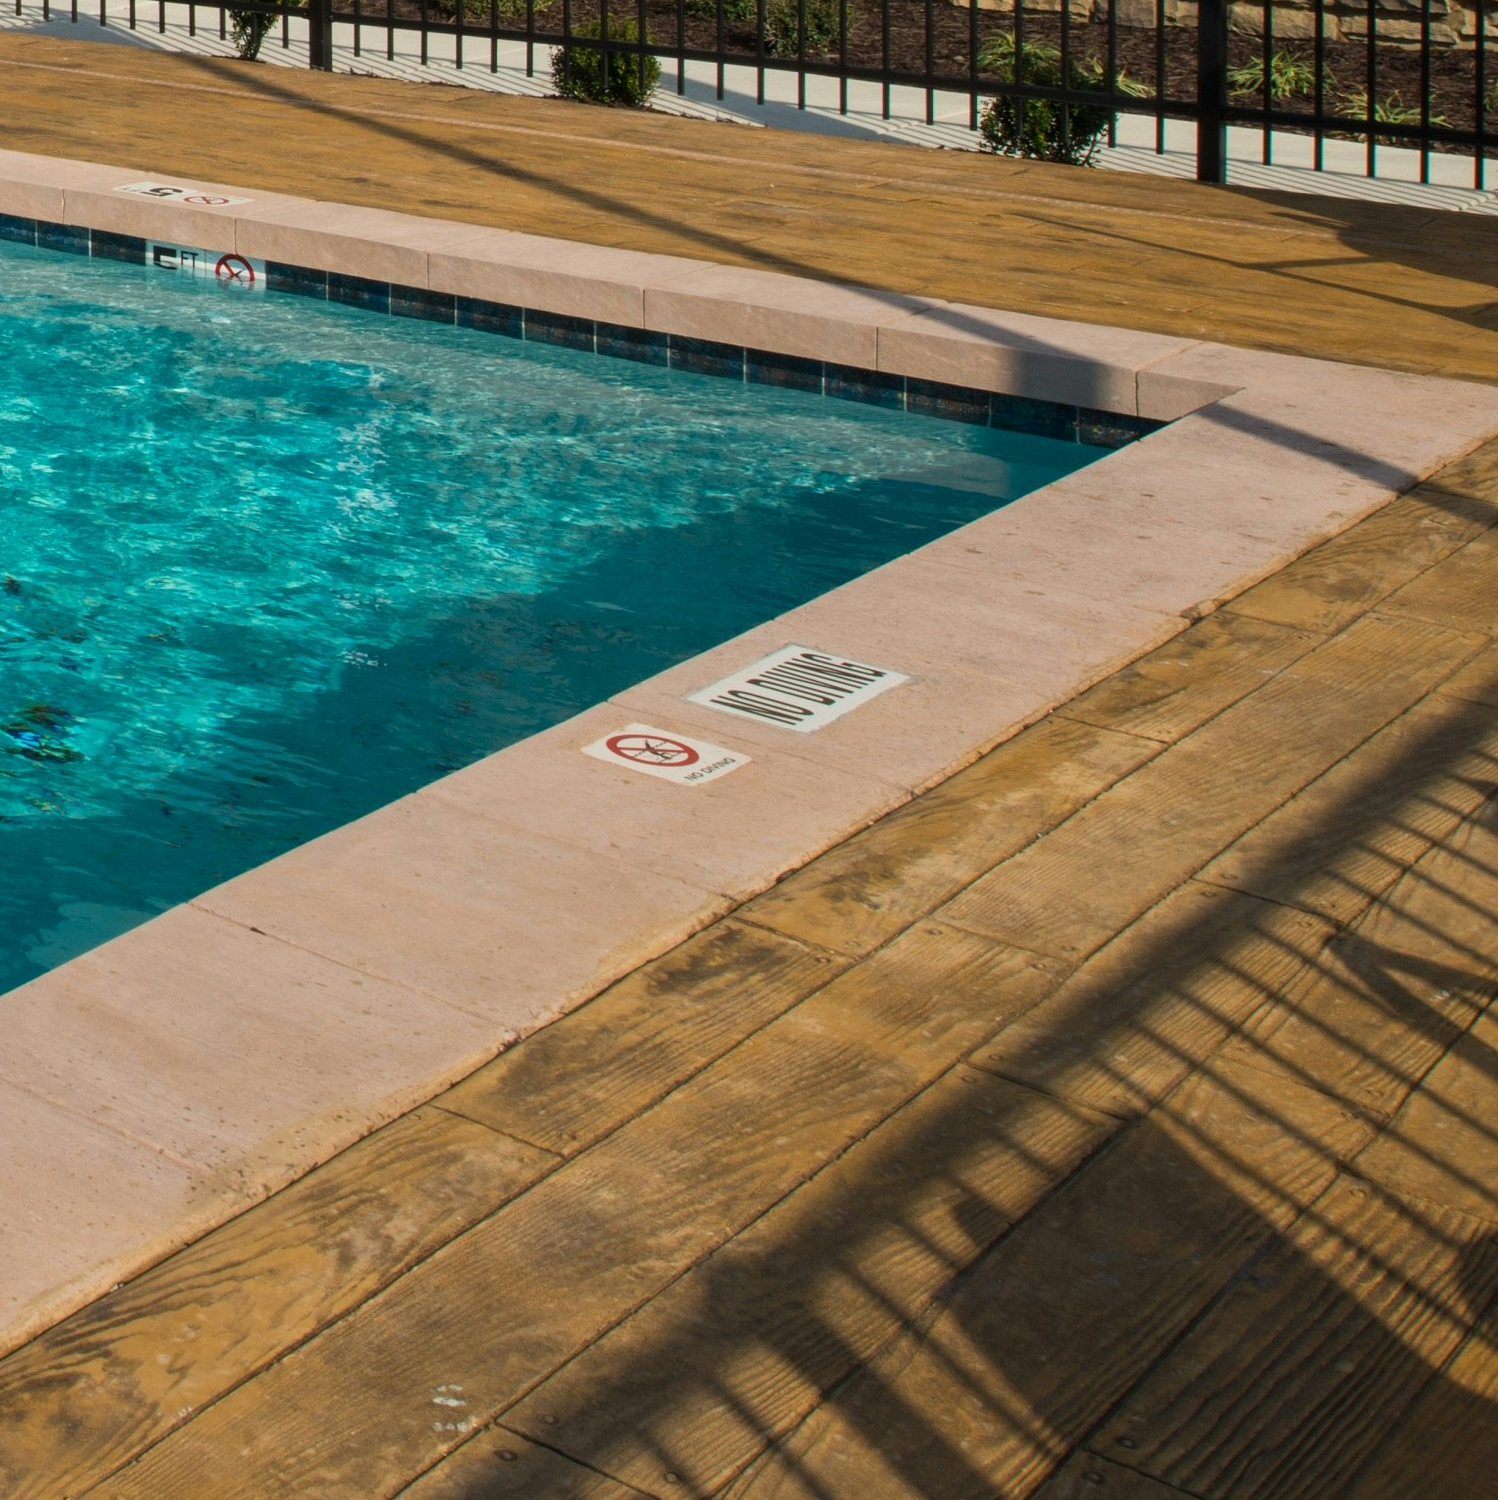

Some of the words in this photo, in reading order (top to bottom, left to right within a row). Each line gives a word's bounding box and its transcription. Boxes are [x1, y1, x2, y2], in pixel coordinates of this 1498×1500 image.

[180, 251, 198, 268] FT
[746, 652, 888, 706] DIVING
[709, 688, 814, 725] NO
[684, 771, 705, 781] NO
[700, 757, 736, 777] DIVING
